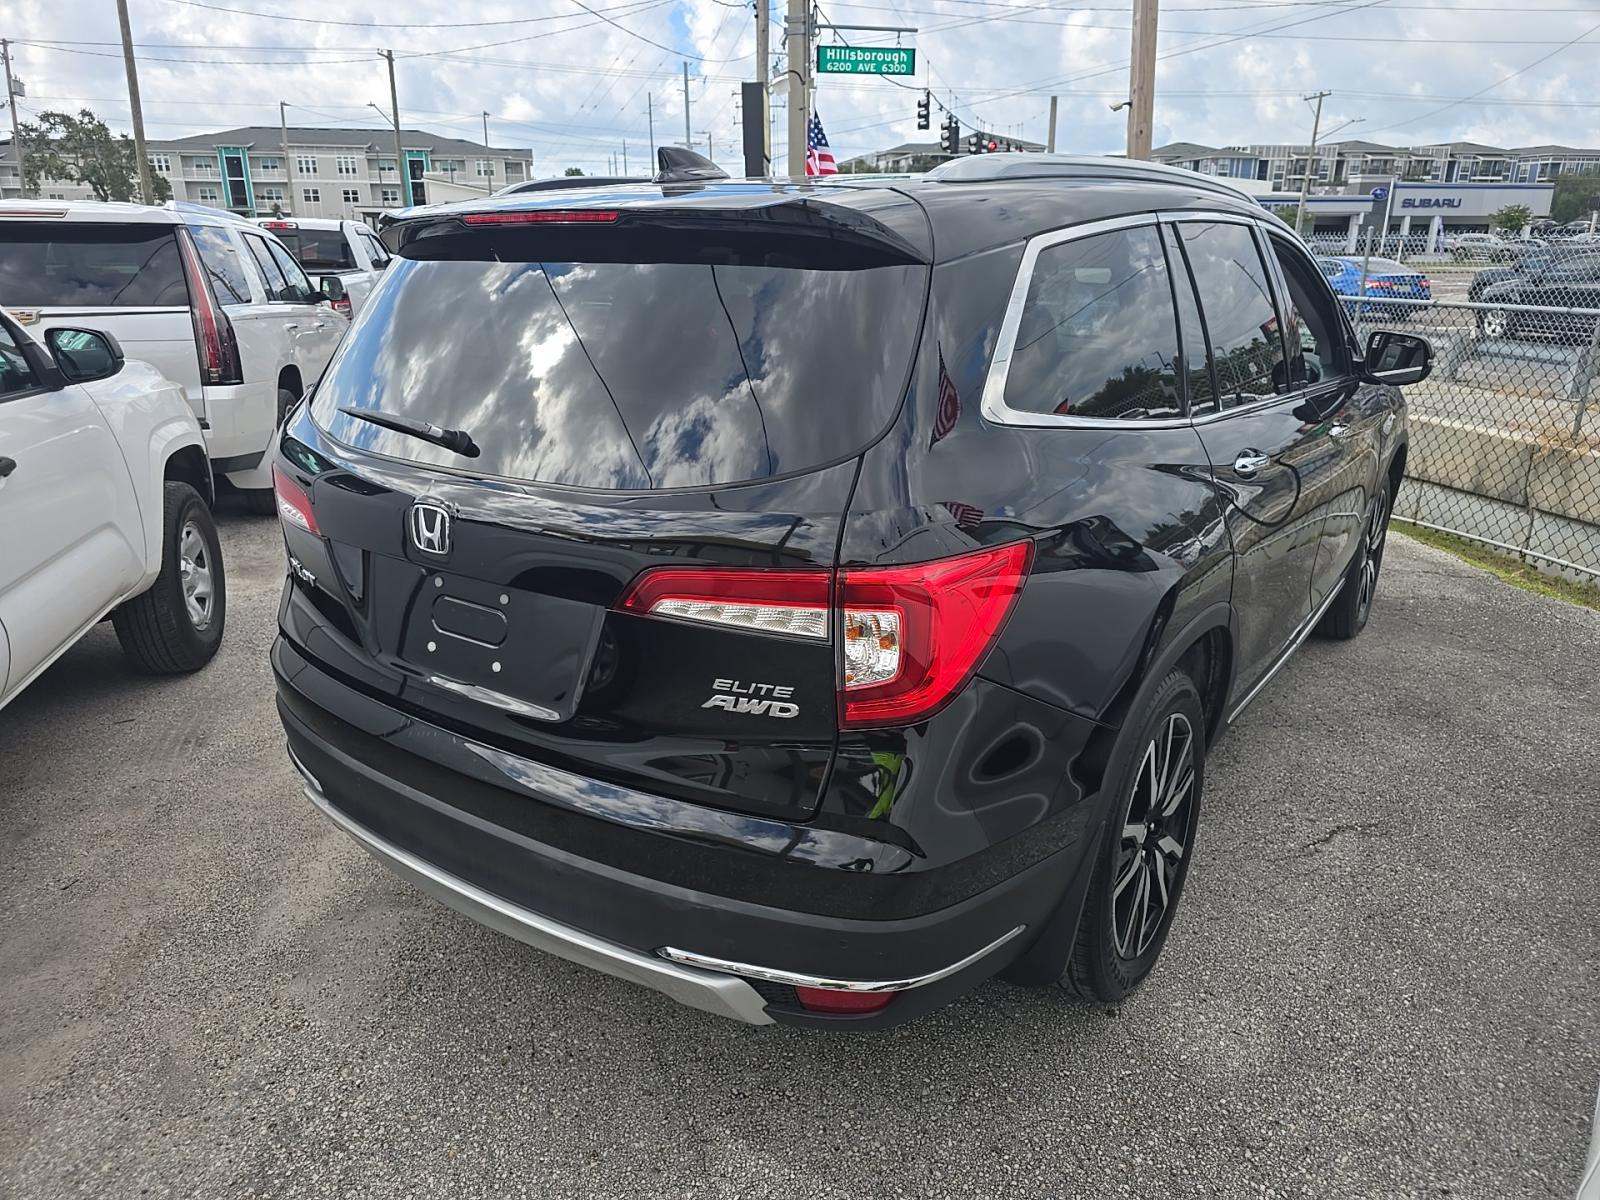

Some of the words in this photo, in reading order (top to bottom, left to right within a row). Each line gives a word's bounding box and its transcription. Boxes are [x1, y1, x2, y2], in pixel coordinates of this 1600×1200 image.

[826, 48, 908, 64] Hillsborough
[826, 62, 852, 71] 6200
[857, 63, 877, 72] AVE
[881, 64, 907, 73] 6300
[1401, 198, 1462, 208] SUBARU
[712, 678, 795, 698] ELITE
[701, 694, 800, 718] AWD
